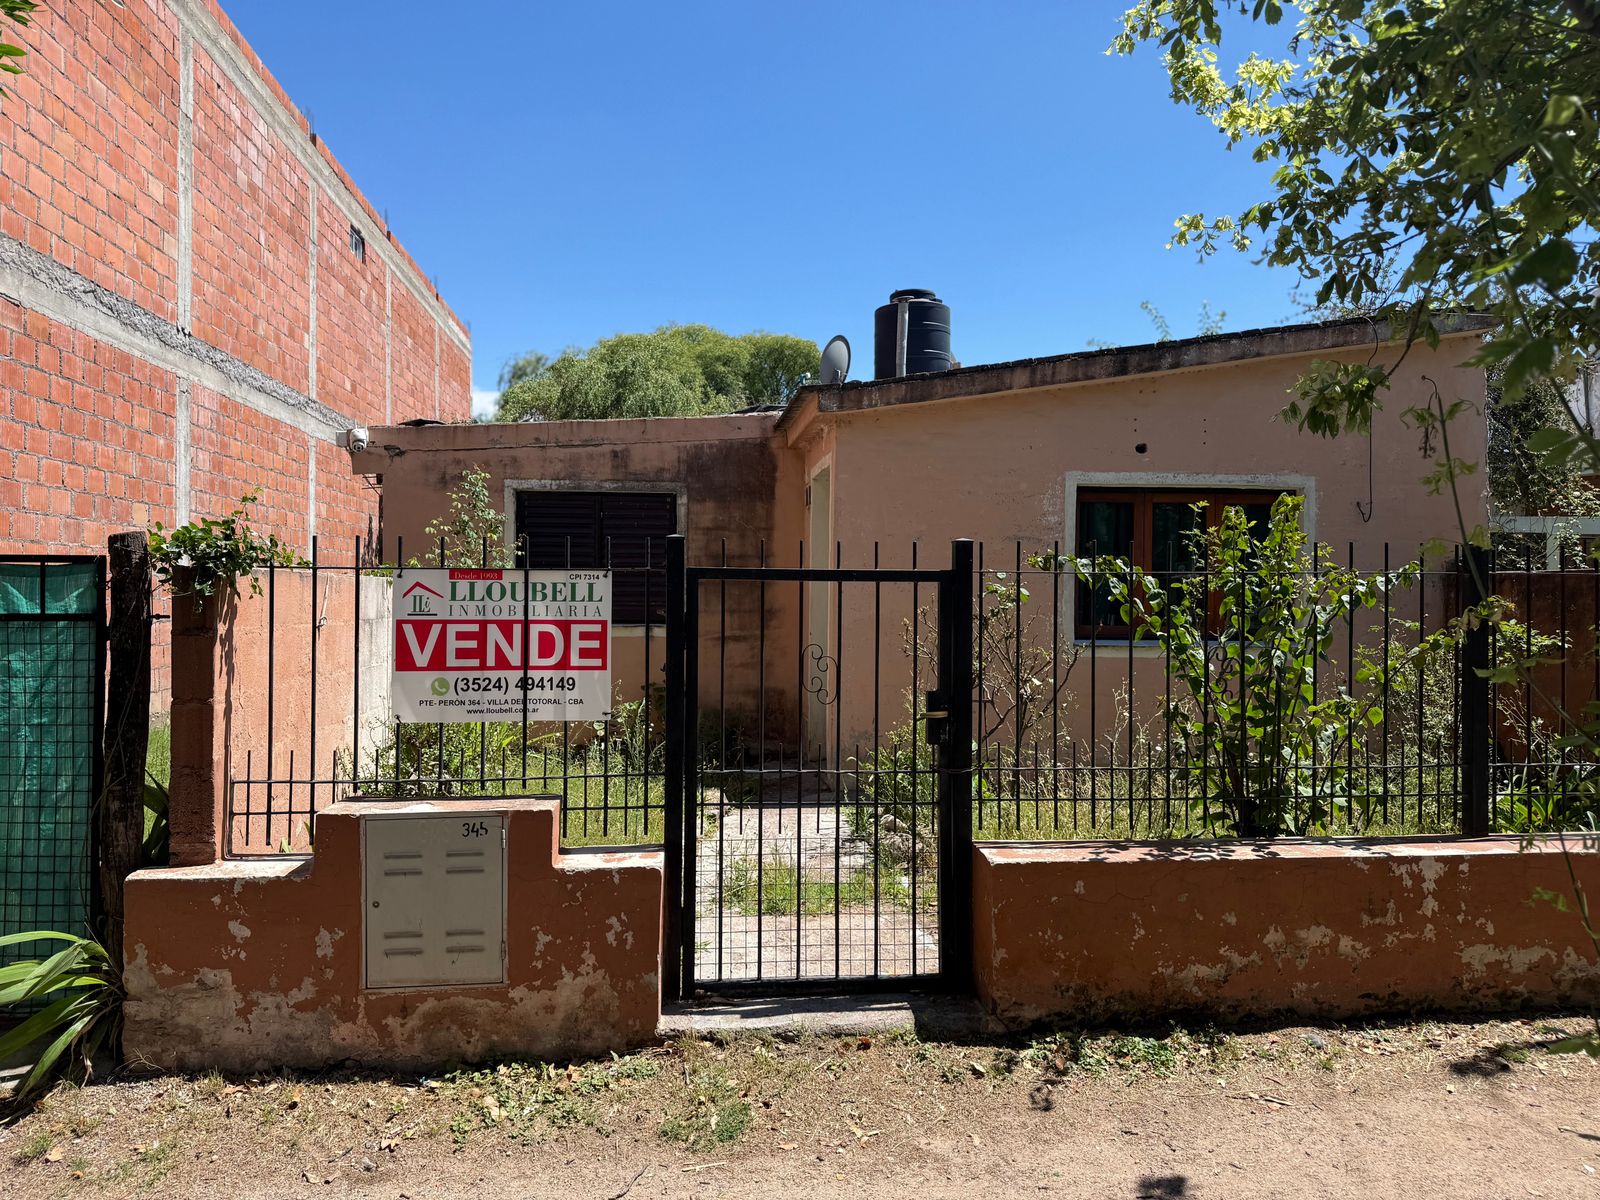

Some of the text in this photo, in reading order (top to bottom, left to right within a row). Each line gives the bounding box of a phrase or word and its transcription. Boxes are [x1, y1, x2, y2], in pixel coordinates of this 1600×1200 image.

[454, 571, 498, 580] Desde 1993
[569, 573, 600, 581] CPI 7314
[449, 581, 603, 602] LLOUBELL
[402, 624, 602, 667] VENDE
[454, 676, 576, 695] (3524) 494149
[438, 697, 466, 706] PERÓN
[487, 698, 509, 706] VILLA
[462, 821, 489, 838] 345
